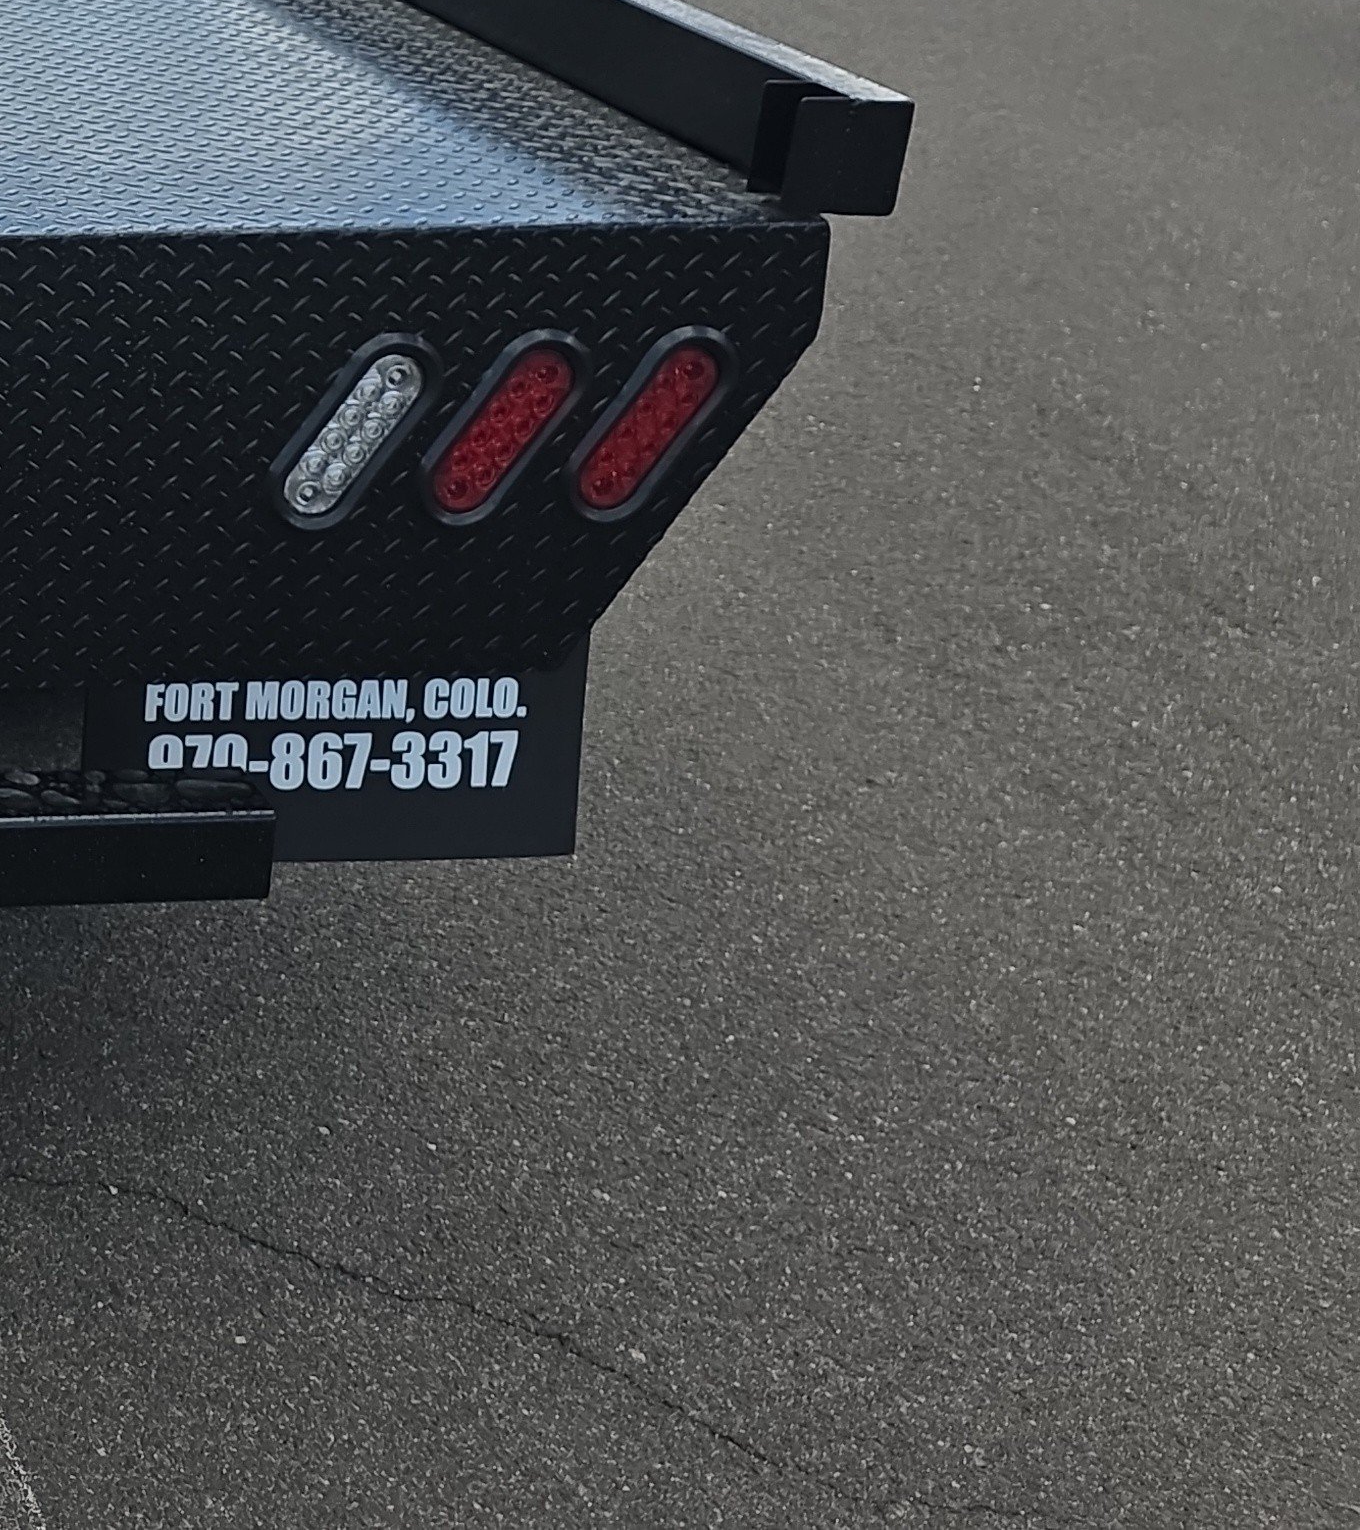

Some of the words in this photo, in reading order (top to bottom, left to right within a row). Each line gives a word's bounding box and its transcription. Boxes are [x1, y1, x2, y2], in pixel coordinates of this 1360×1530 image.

[144, 682, 240, 722] FORT
[245, 679, 416, 724] MORGAN,
[424, 676, 527, 720] COLO.
